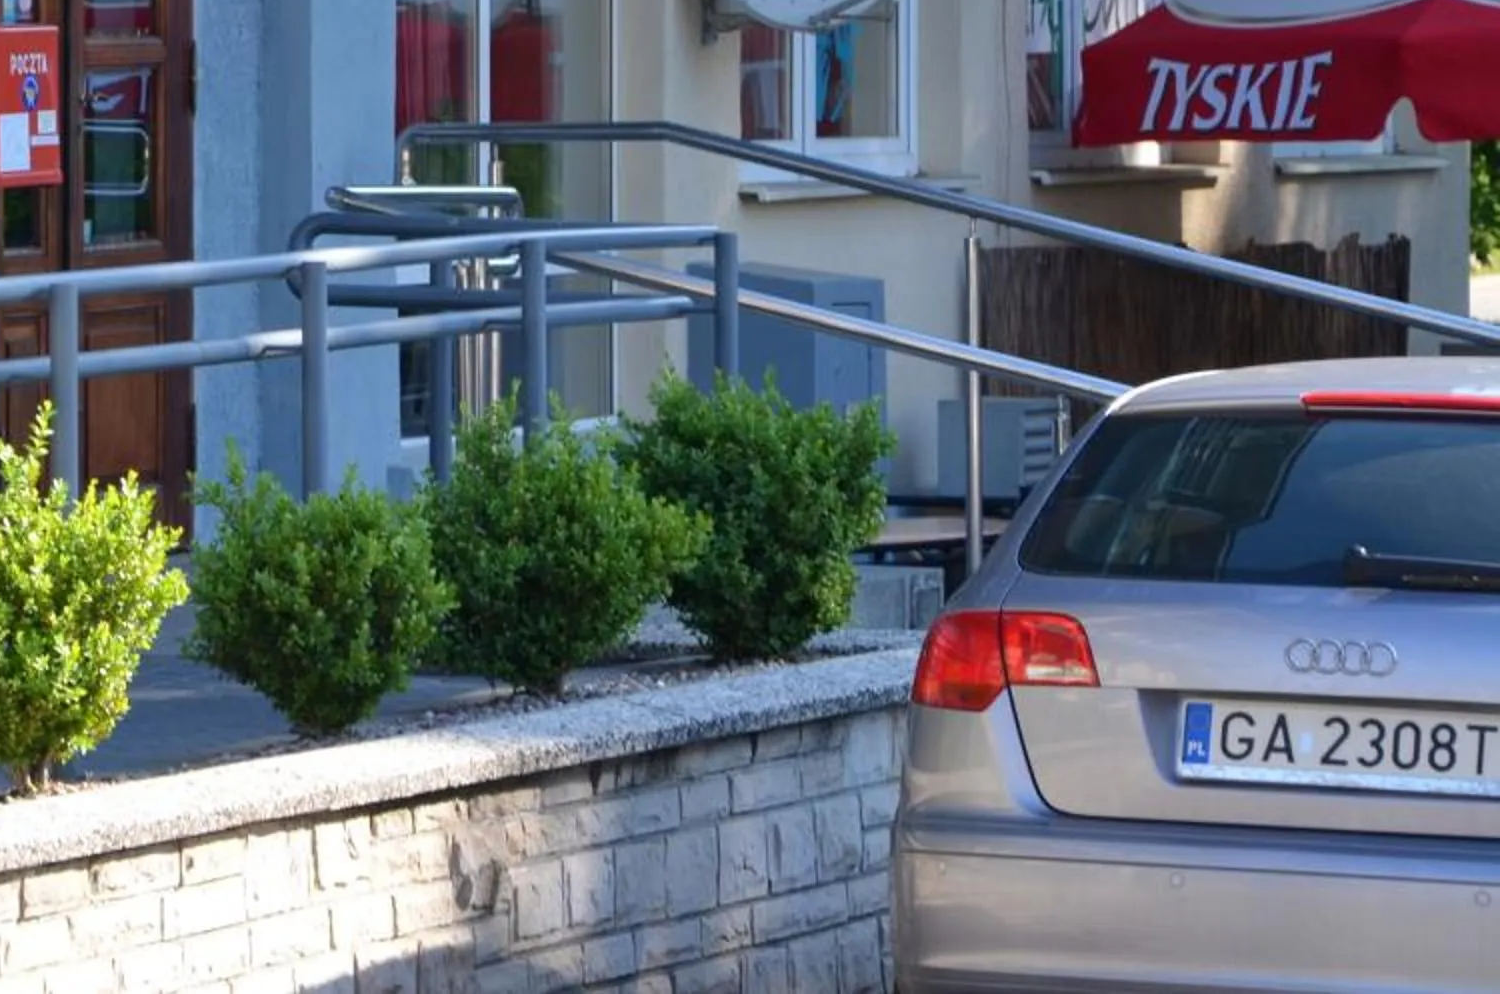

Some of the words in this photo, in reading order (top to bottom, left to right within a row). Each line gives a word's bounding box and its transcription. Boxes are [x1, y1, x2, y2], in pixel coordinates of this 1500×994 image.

[9, 52, 49, 76] POCZTA
[1139, 50, 1333, 132] TYSKIE
[1187, 740, 1206, 758] PL
[1220, 710, 1295, 764] GA
[1320, 716, 1499, 775] 2308T
